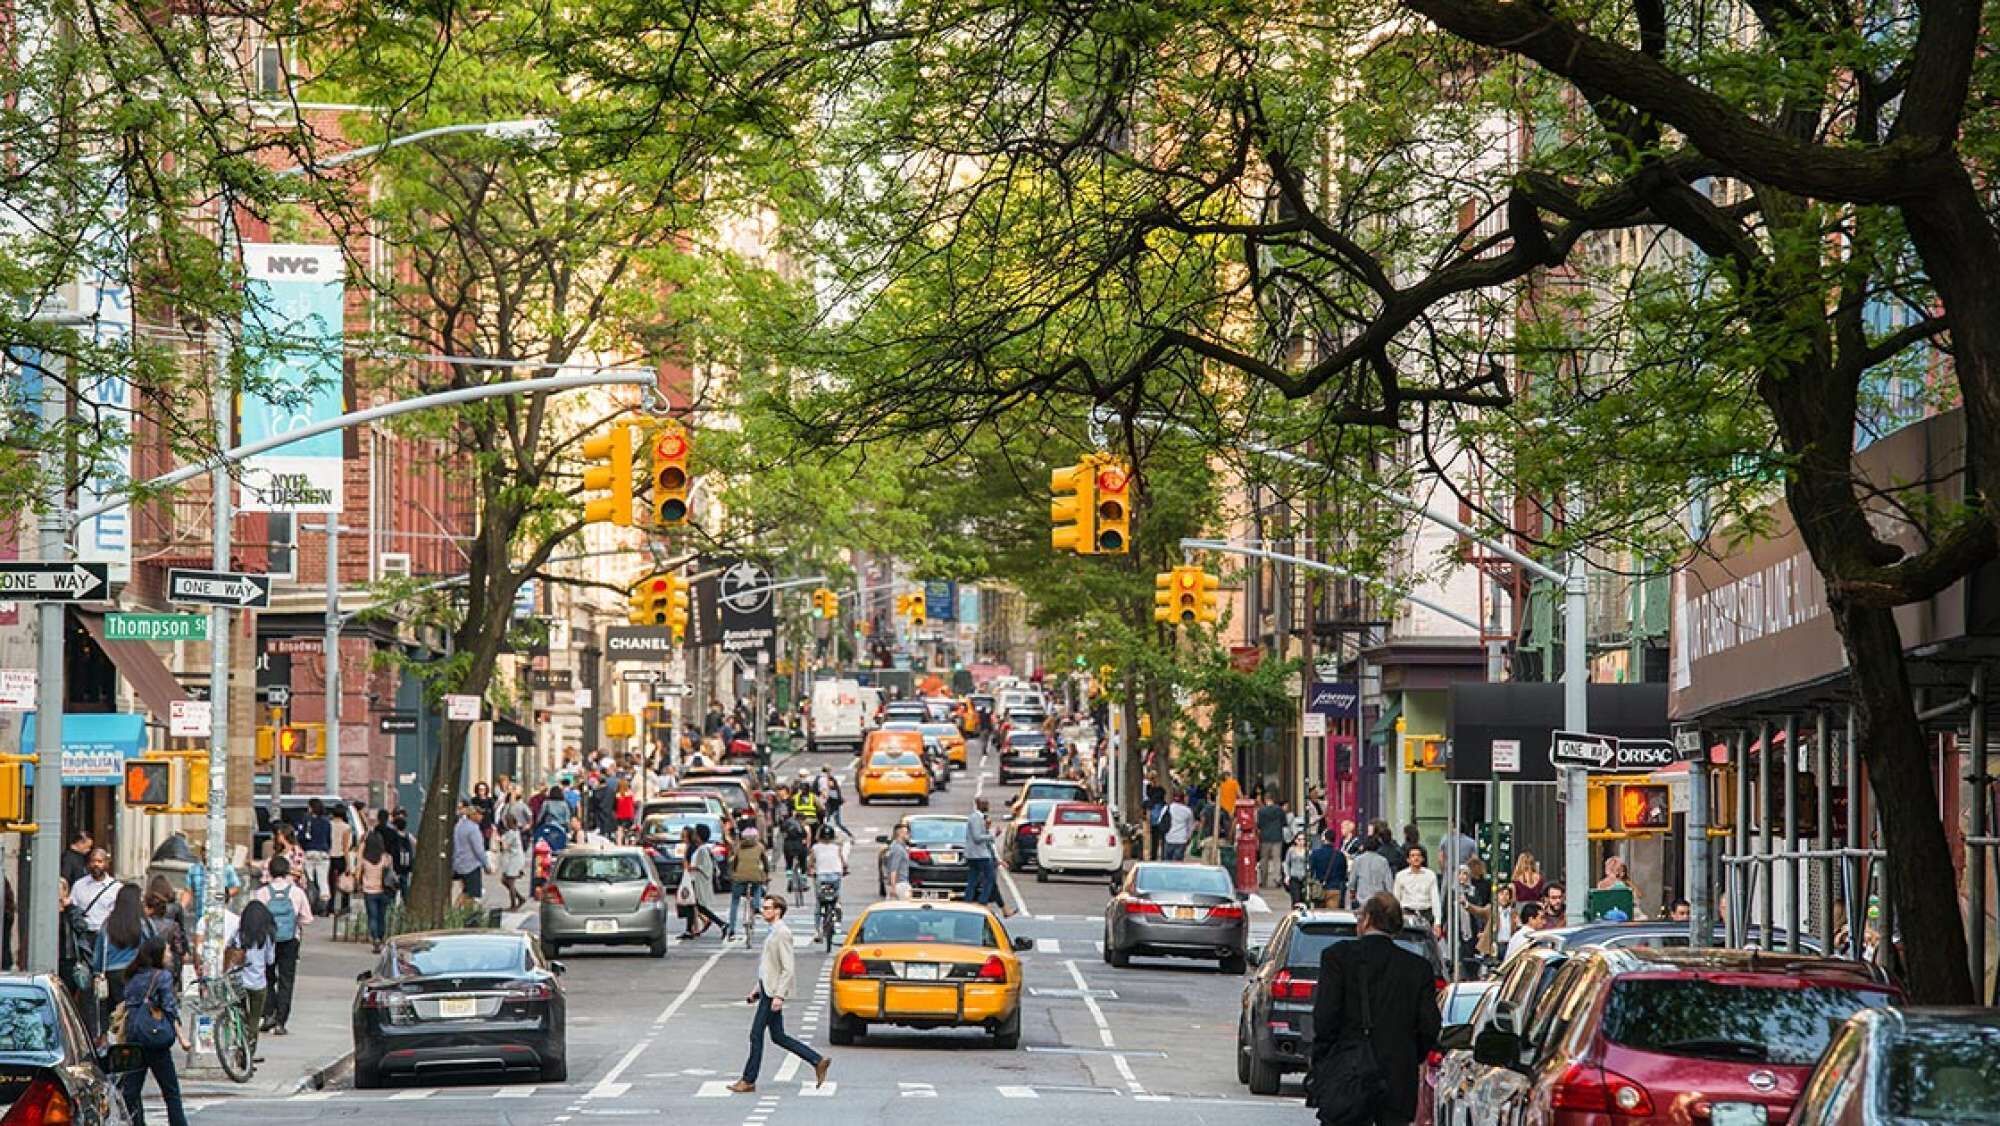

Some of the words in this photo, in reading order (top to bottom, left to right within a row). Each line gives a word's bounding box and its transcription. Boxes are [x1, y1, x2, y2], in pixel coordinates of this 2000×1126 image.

[267, 256, 318, 273] NYC
[3, 574, 37, 588] ONE
[53, 574, 88, 588] WAY
[183, 580, 211, 593] ONE
[224, 583, 254, 597] WAY
[108, 617, 189, 639] Thompson
[610, 637, 670, 650] CHANEL
[1563, 742, 1583, 757] ONE
[1617, 748, 1672, 763] ORTSAC
